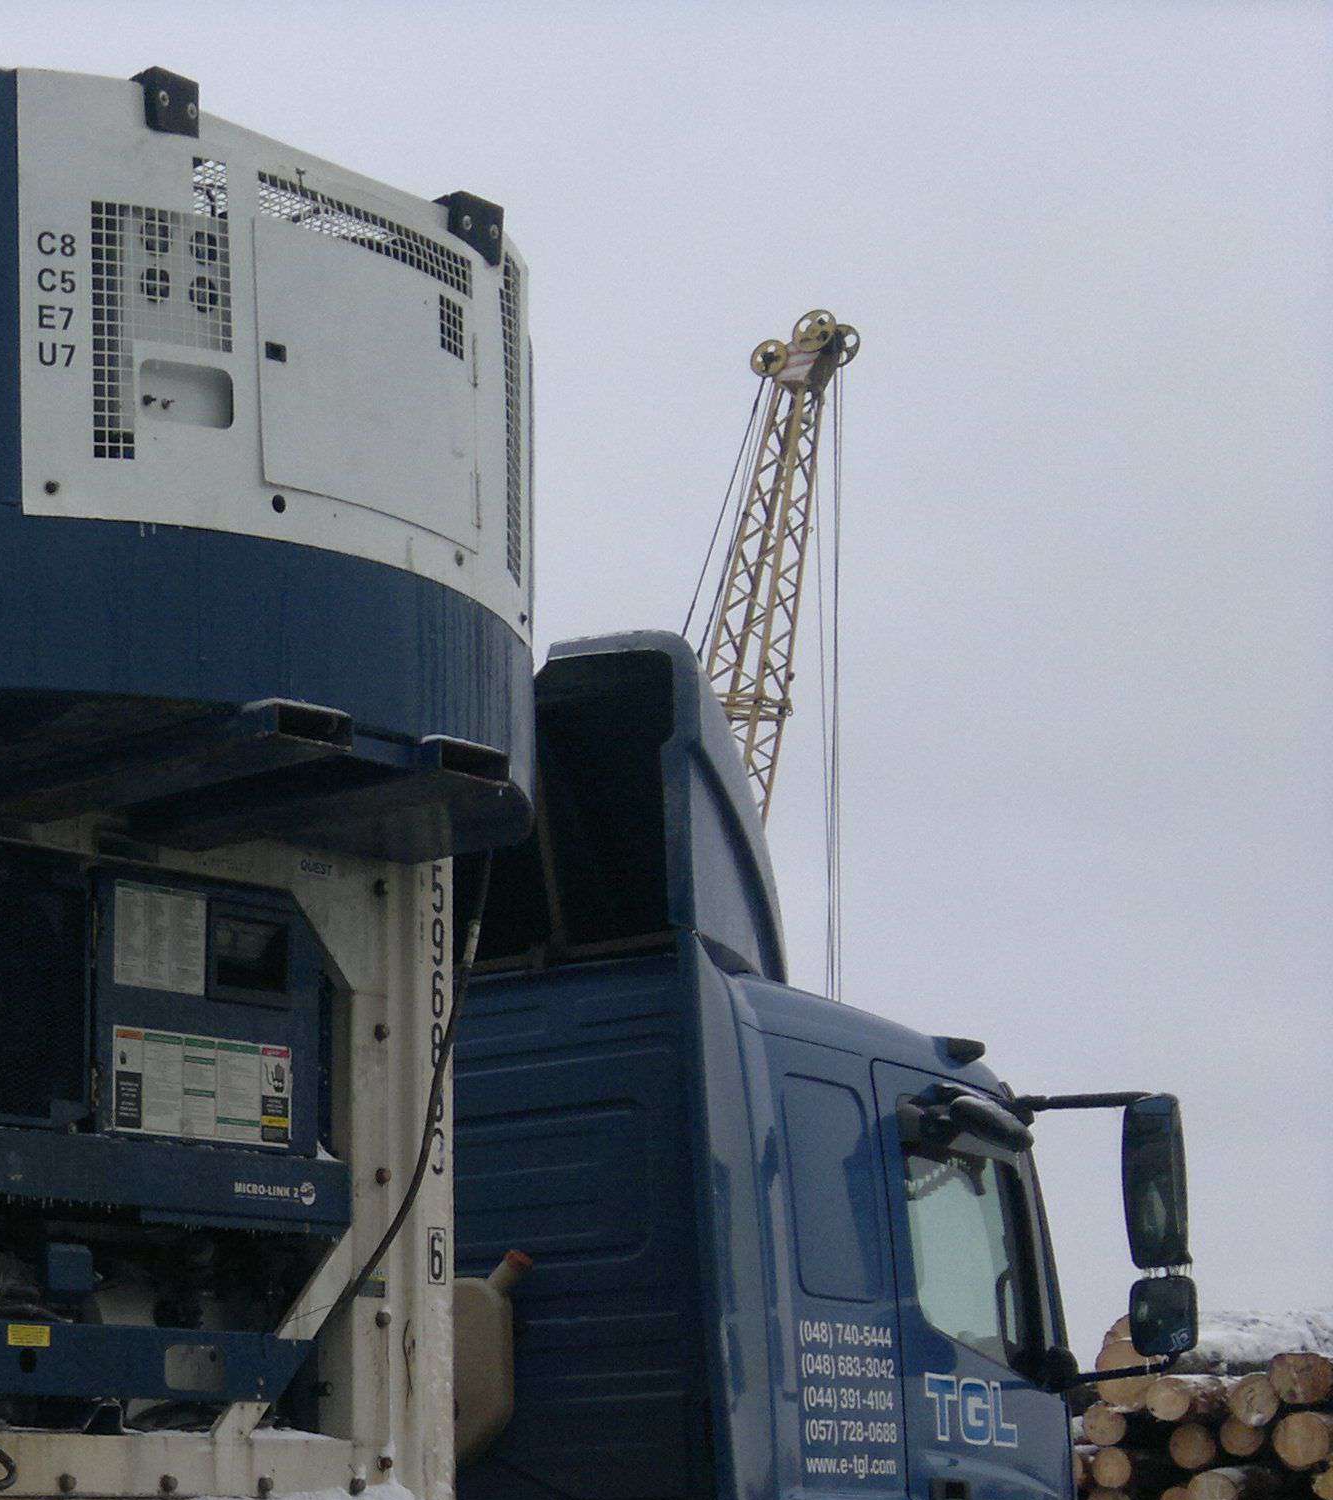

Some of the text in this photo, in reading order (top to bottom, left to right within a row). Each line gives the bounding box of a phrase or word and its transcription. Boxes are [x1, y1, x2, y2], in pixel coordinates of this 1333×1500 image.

[430, 1230, 444, 1282] 6
[799, 1320, 893, 1349] (048) 740-5444
[801, 1353, 895, 1380] (048) 683-3042
[803, 1385, 894, 1412] (044) 391-4104
[924, 1371, 1019, 1449] TGL
[805, 1419, 839, 1447] (057)
[806, 1455, 897, 1479] www.e-tgl.com
